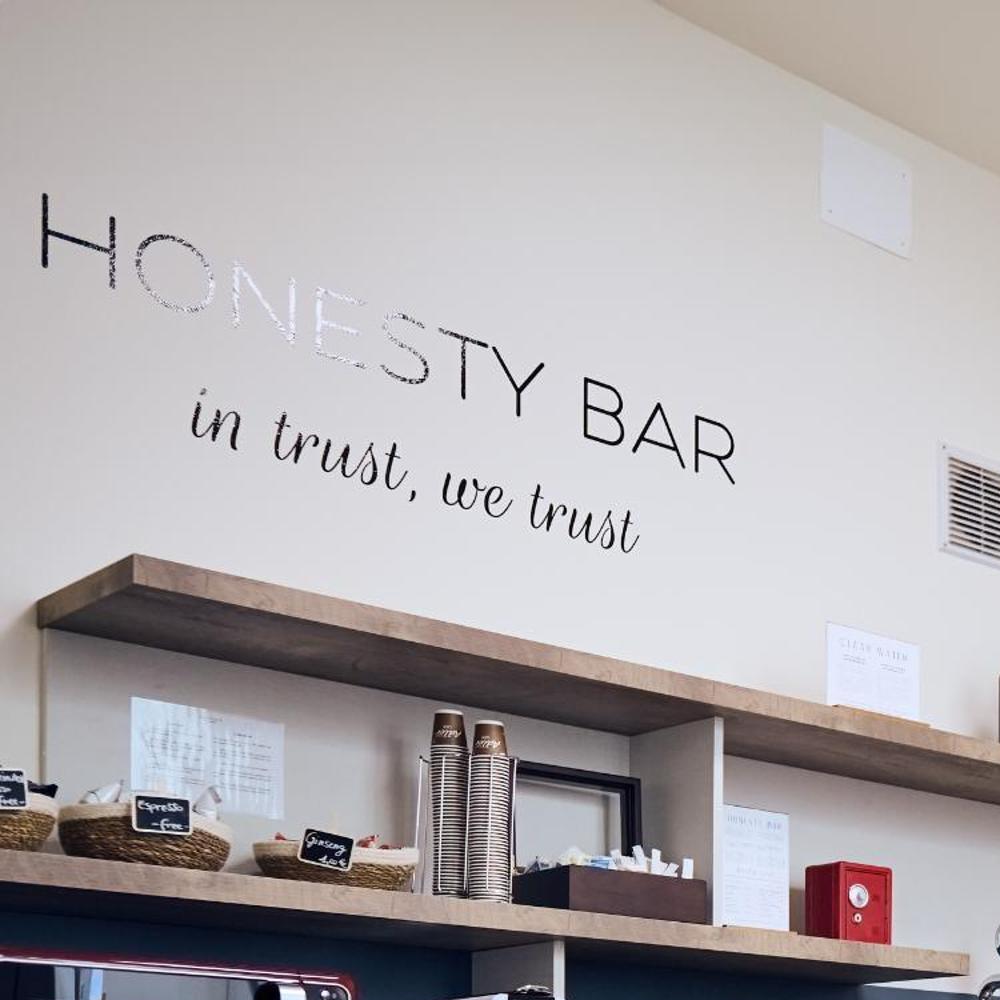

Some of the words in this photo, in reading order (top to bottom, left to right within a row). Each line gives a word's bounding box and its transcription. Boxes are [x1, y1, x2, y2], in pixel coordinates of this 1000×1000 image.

[40, 192, 546, 416] HONESTY
[583, 377, 736, 484] BAR
[190, 387, 242, 451] in
[273, 411, 418, 503] trust,
[441, 470, 514, 518] we
[529, 483, 641, 554] trust
